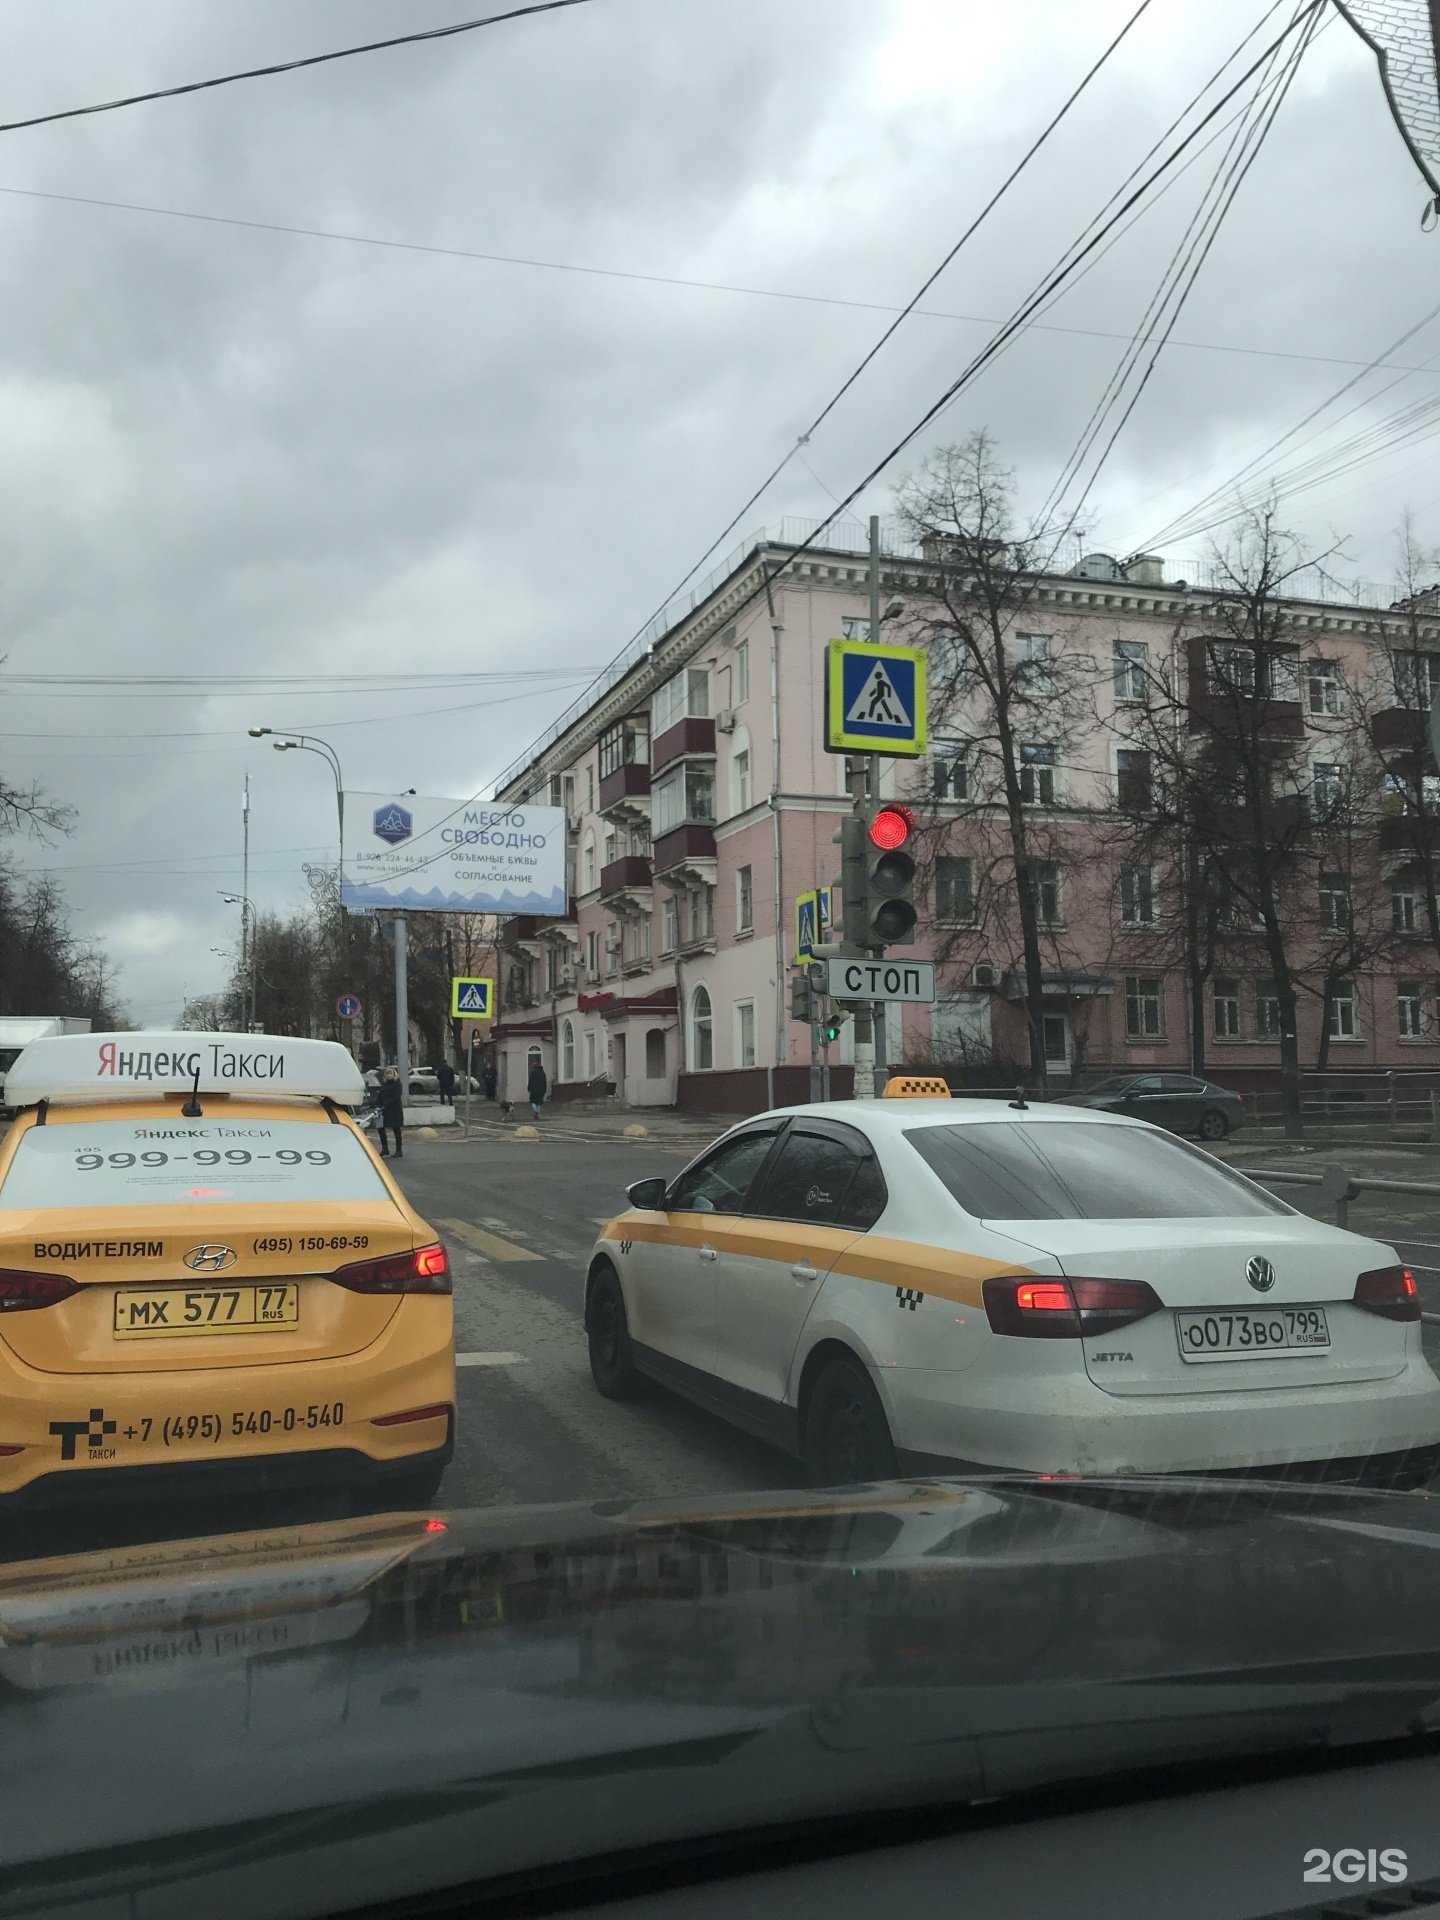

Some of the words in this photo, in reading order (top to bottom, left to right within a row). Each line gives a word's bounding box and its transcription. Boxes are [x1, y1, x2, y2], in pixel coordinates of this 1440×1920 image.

[463, 811, 526, 828] МЕСТО
[441, 828, 546, 849] СВОБОДНО
[508, 855, 538, 866] БУКВЫ
[454, 871, 533, 884] СОГЛАСОВАНИЕ
[845, 965, 921, 995] СТОП
[97, 1042, 201, 1080] Яндекс
[209, 1044, 284, 1078] Такси
[134, 1128, 210, 1140] Яндекс
[216, 1127, 272, 1139] Такси
[75, 1149, 332, 1171] 999-99-99
[34, 1241, 163, 1261] ВОДИТЕЛЯМ
[253, 1238, 293, 1254] (495)
[298, 1236, 369, 1251] 150-69-59
[258, 1288, 288, 1311] 77
[262, 1310, 284, 1320] RUS
[1285, 1311, 1320, 1335] 799
[1296, 1334, 1314, 1344] RUS
[1091, 1352, 1134, 1363] JETTA
[122, 1418, 153, 1442] +7
[163, 1414, 223, 1446] (495)
[232, 1403, 345, 1437] 540-0-540
[88, 1448, 116, 1460] ТАКСИ
